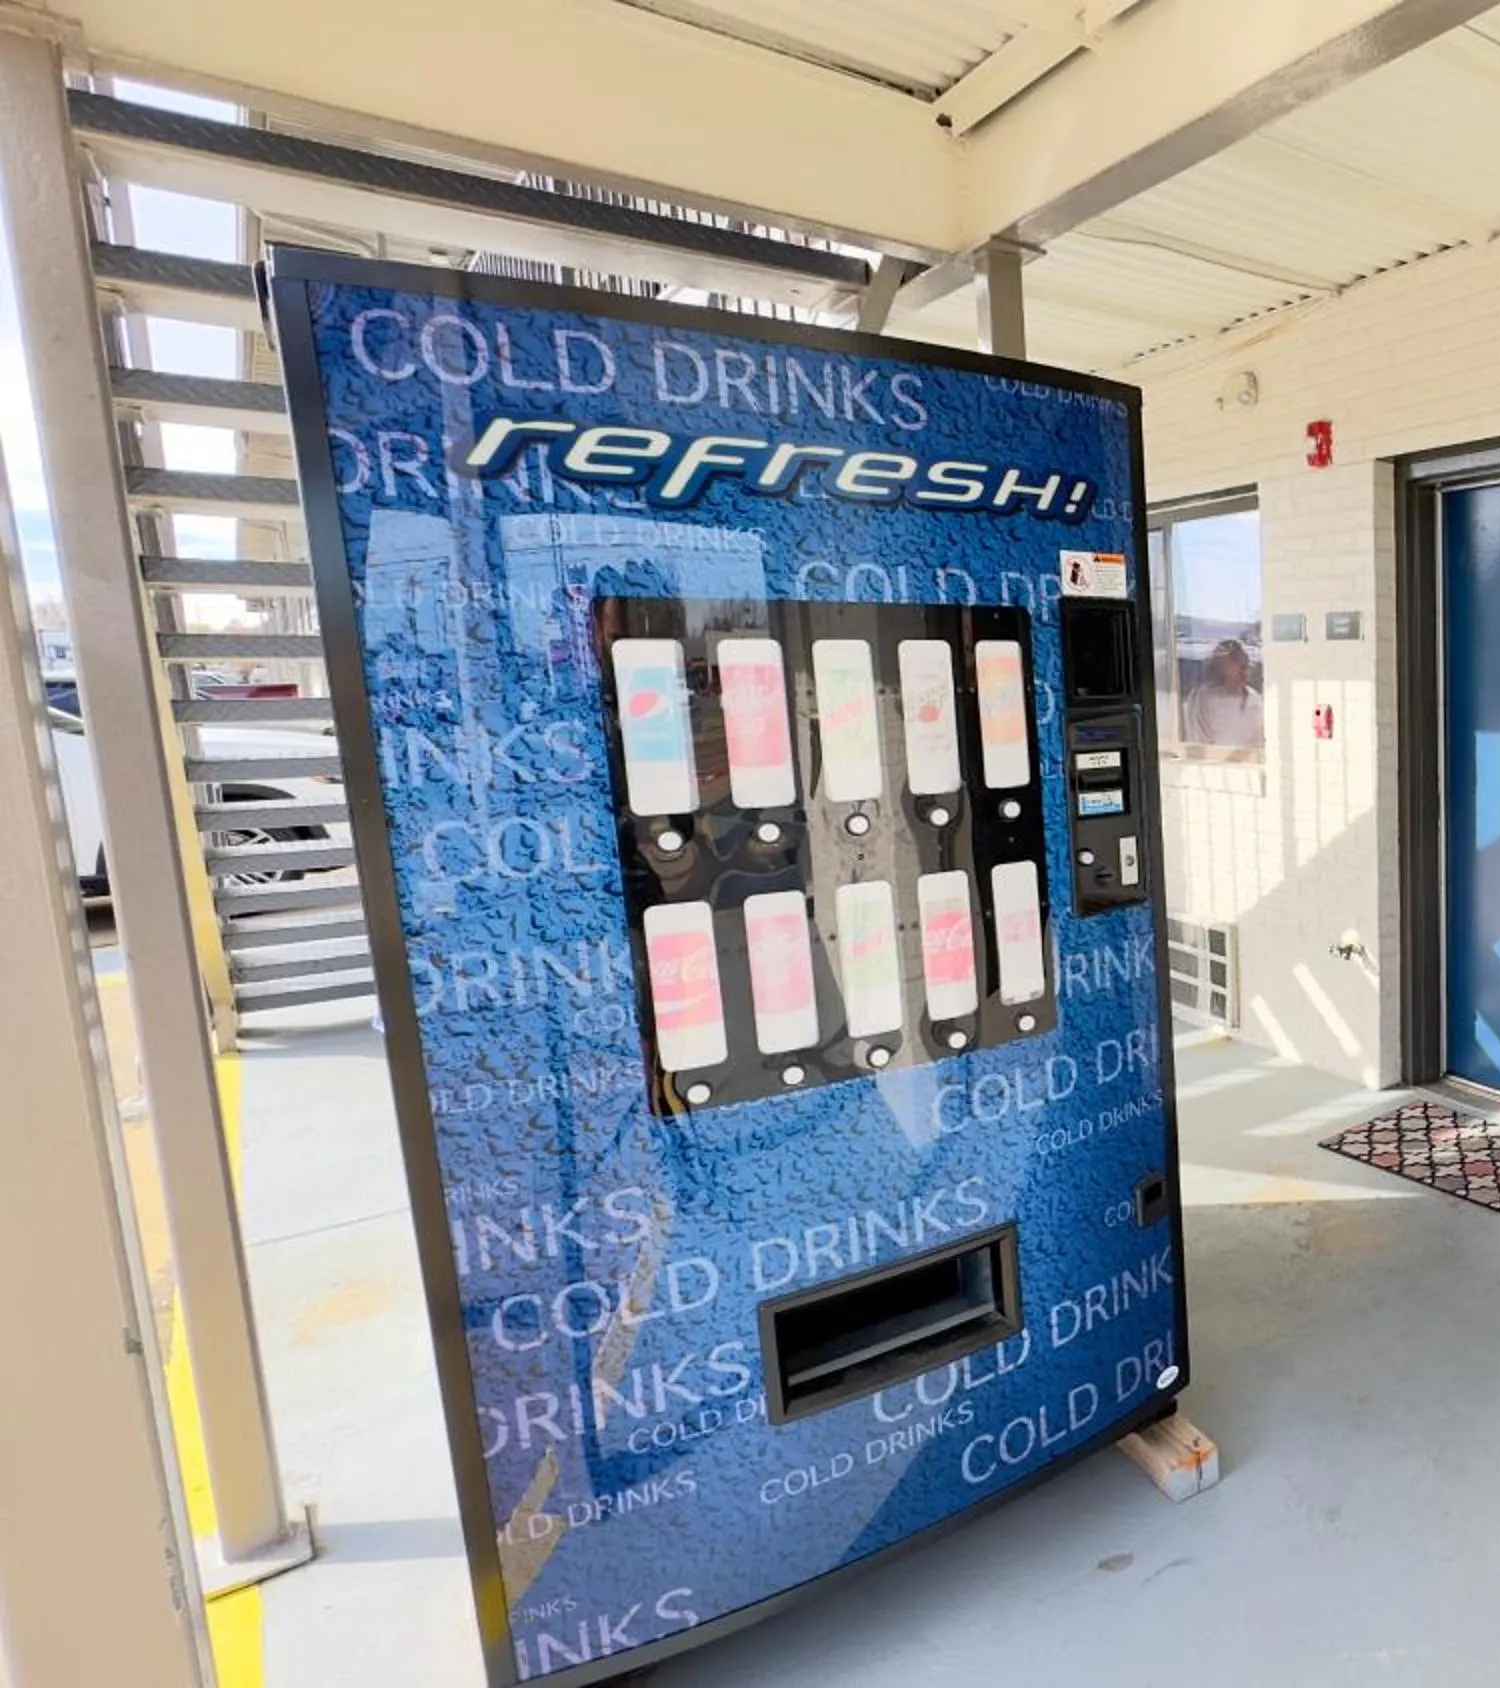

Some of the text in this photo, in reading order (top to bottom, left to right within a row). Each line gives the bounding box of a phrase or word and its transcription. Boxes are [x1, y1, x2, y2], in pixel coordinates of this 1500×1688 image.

[351, 307, 928, 432] COLD DRINKS
[932, 1024, 1158, 1133] COLD DRI
[1036, 1089, 1163, 1155] COLD DRINKS
[452, 1187, 651, 1276] INKS
[492, 1176, 989, 1351] COLD DRINKS
[872, 1246, 1173, 1424] COLD DRINK
[478, 1341, 750, 1460] DRINKS
[628, 1409, 722, 1454] COLD
[960, 1383, 1100, 1485] COLD
[567, 1470, 699, 1529] DRINKS
[760, 1401, 975, 1505] COLD DRINKS
